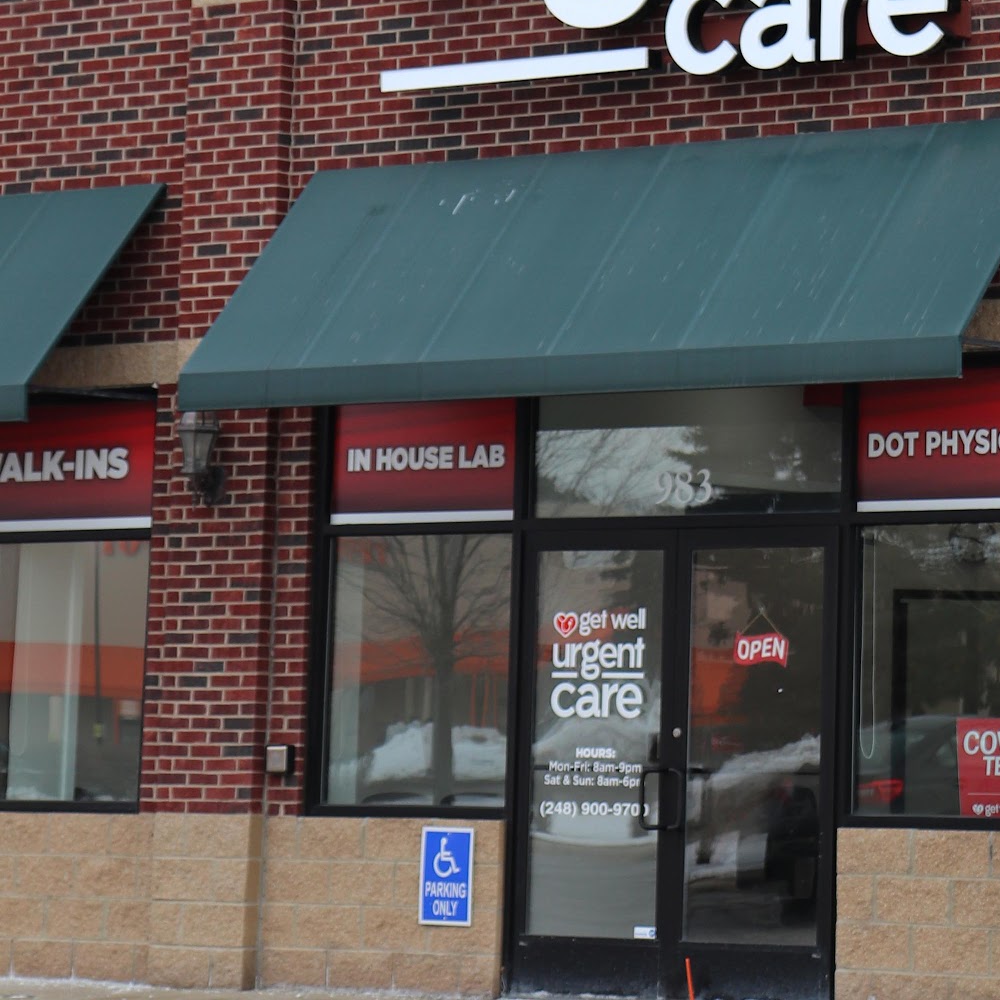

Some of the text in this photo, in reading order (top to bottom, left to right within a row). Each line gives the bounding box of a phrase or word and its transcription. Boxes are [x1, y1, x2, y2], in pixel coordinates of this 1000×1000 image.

[347, 443, 505, 472] IN HOUSE LAB
[867, 431, 920, 458] DOT
[0, 446, 129, 483] ALK-INS
[656, 468, 712, 505] 983
[579, 607, 647, 636] get well
[552, 637, 646, 681] urgent
[737, 636, 785, 661] OPEN
[550, 681, 644, 719] care
[575, 747, 616, 758] HOURS:
[544, 773, 561, 786] Sat
[562, 774, 570, 786] &
[572, 774, 594, 786] Sun:
[548, 760, 643, 774] Mon-Fri: 8am-9pm
[540, 801, 577, 818] (248)
[424, 881, 468, 899] PARKING
[432, 900, 459, 917] ONLY
